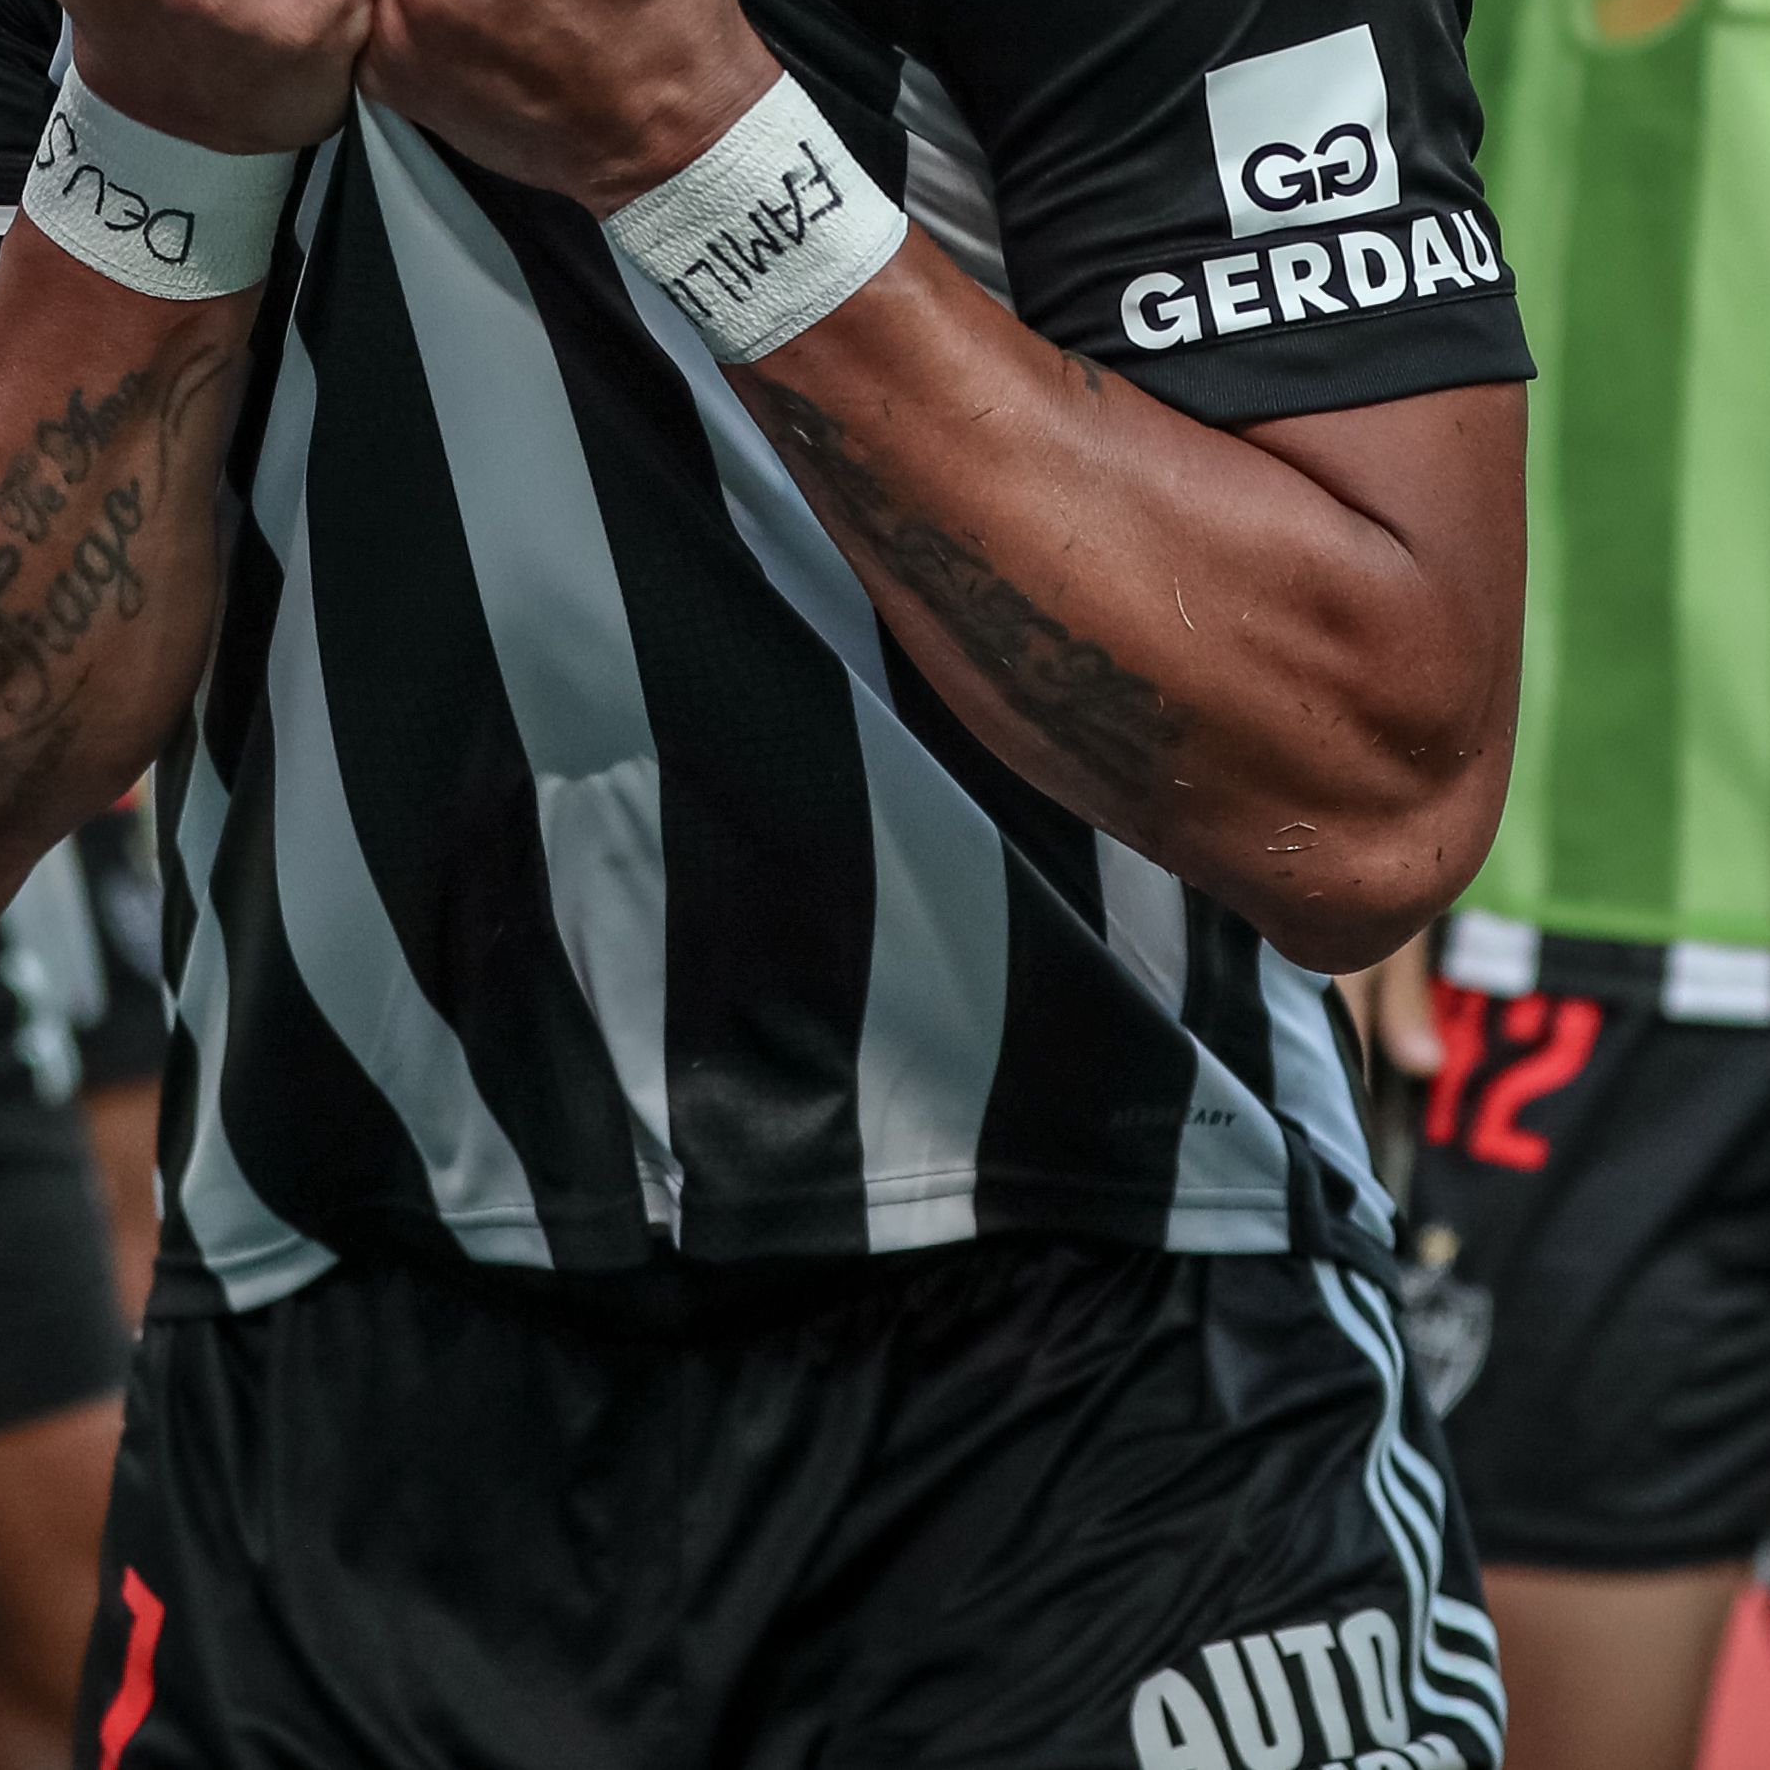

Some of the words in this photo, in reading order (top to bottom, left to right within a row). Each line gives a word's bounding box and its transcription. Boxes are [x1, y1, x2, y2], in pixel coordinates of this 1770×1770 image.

[35, 110, 195, 266] DEUS
[658, 140, 843, 332] FAMILI
[1119, 209, 1503, 351] GERDAU
[1131, 1607, 1412, 1770] AUTO
